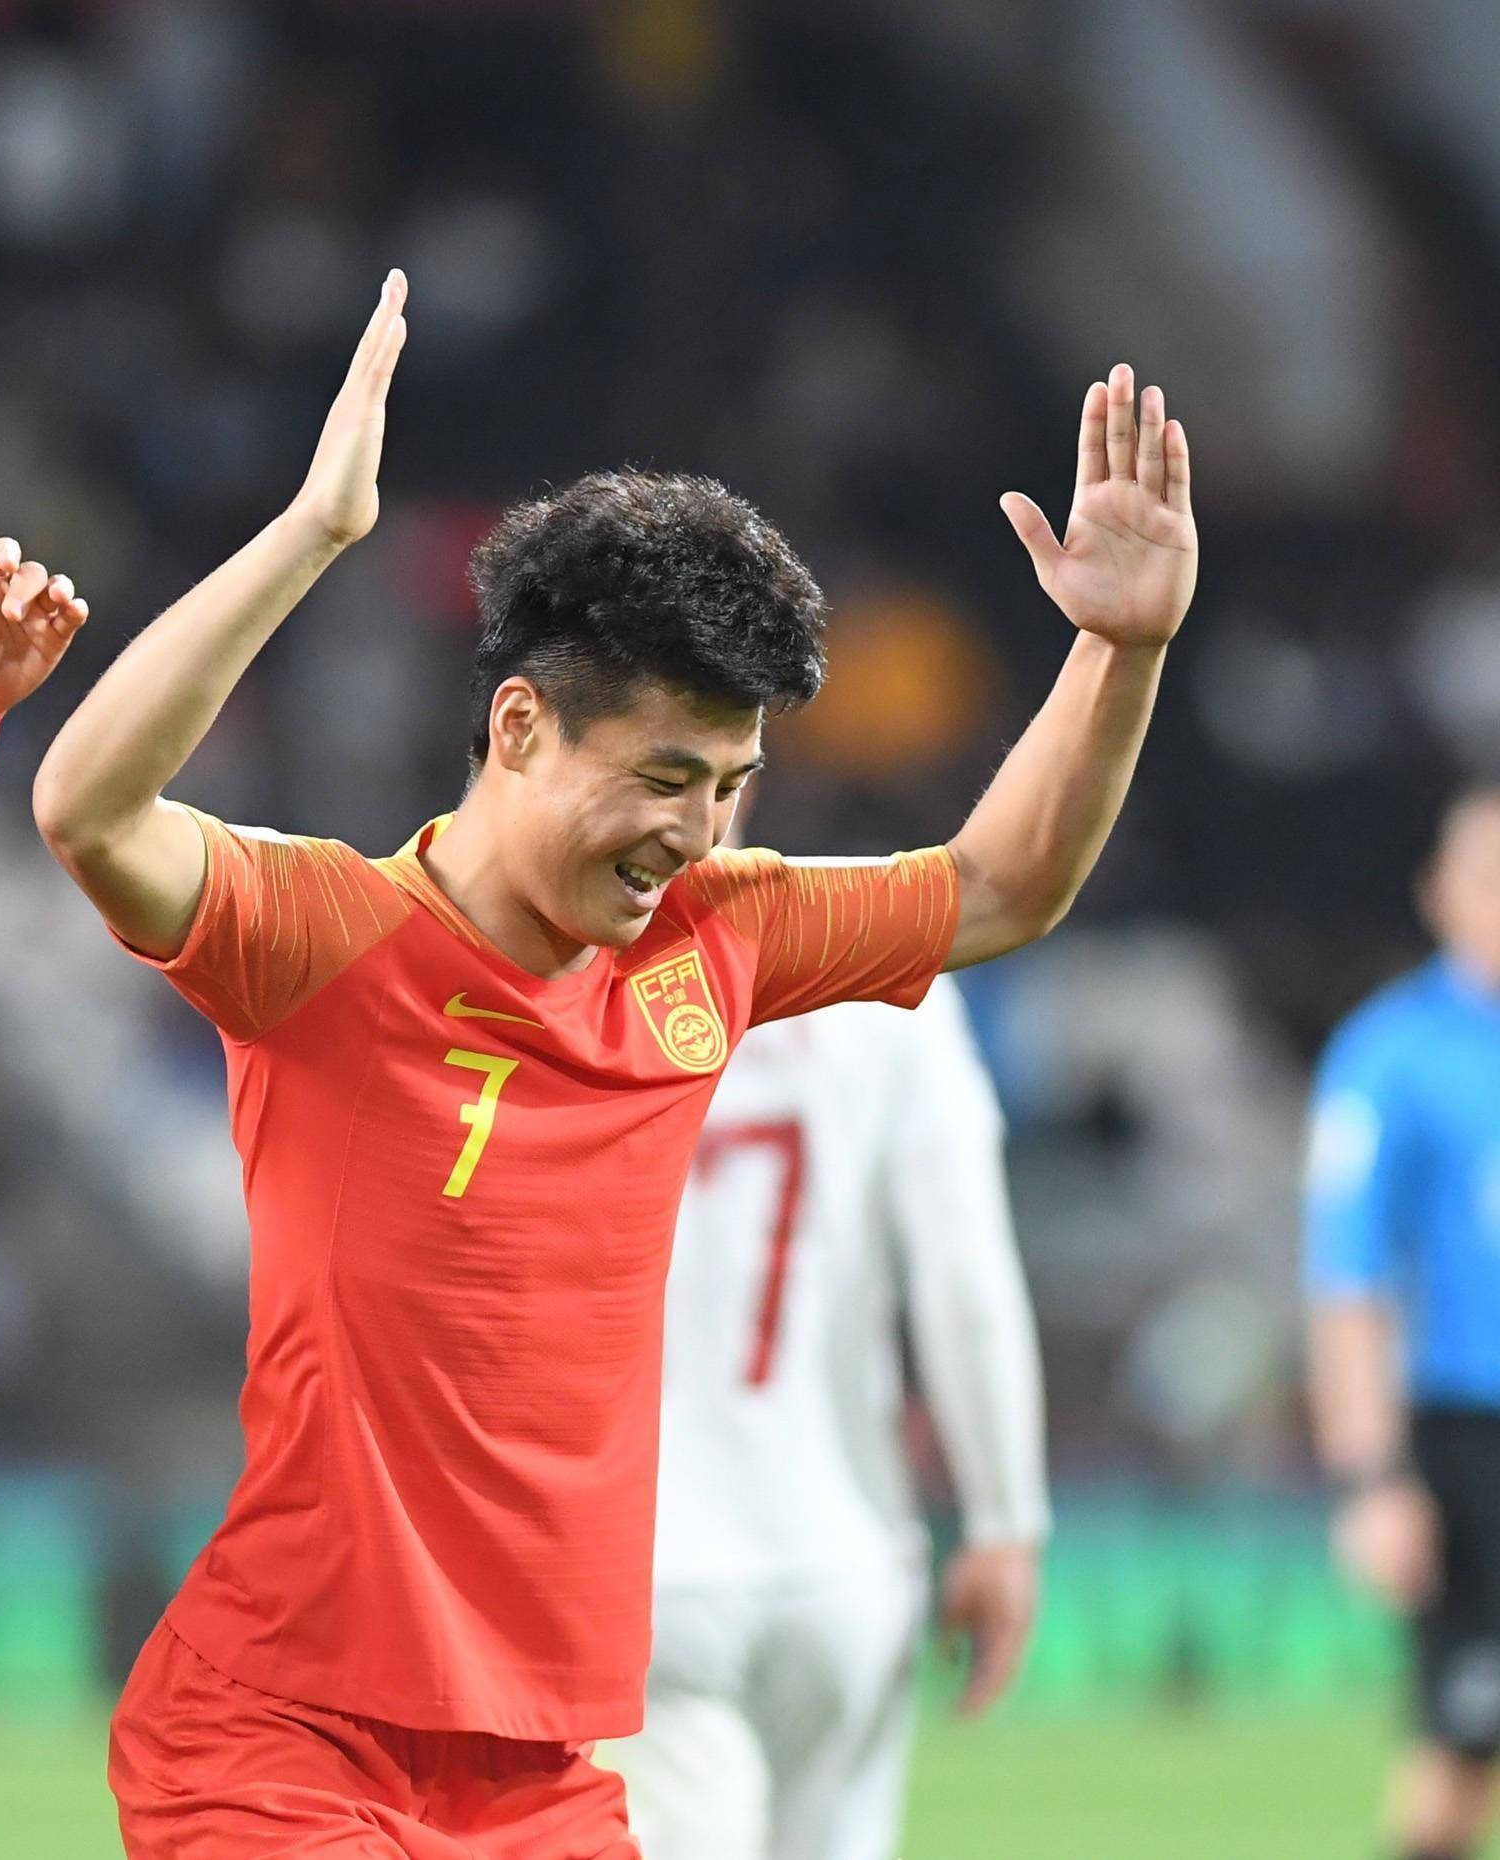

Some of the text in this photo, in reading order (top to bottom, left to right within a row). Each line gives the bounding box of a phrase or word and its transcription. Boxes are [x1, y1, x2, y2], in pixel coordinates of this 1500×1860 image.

[640, 960, 698, 1002] CFA
[442, 1047, 521, 1199] 7
[694, 1116, 808, 1392] 7
